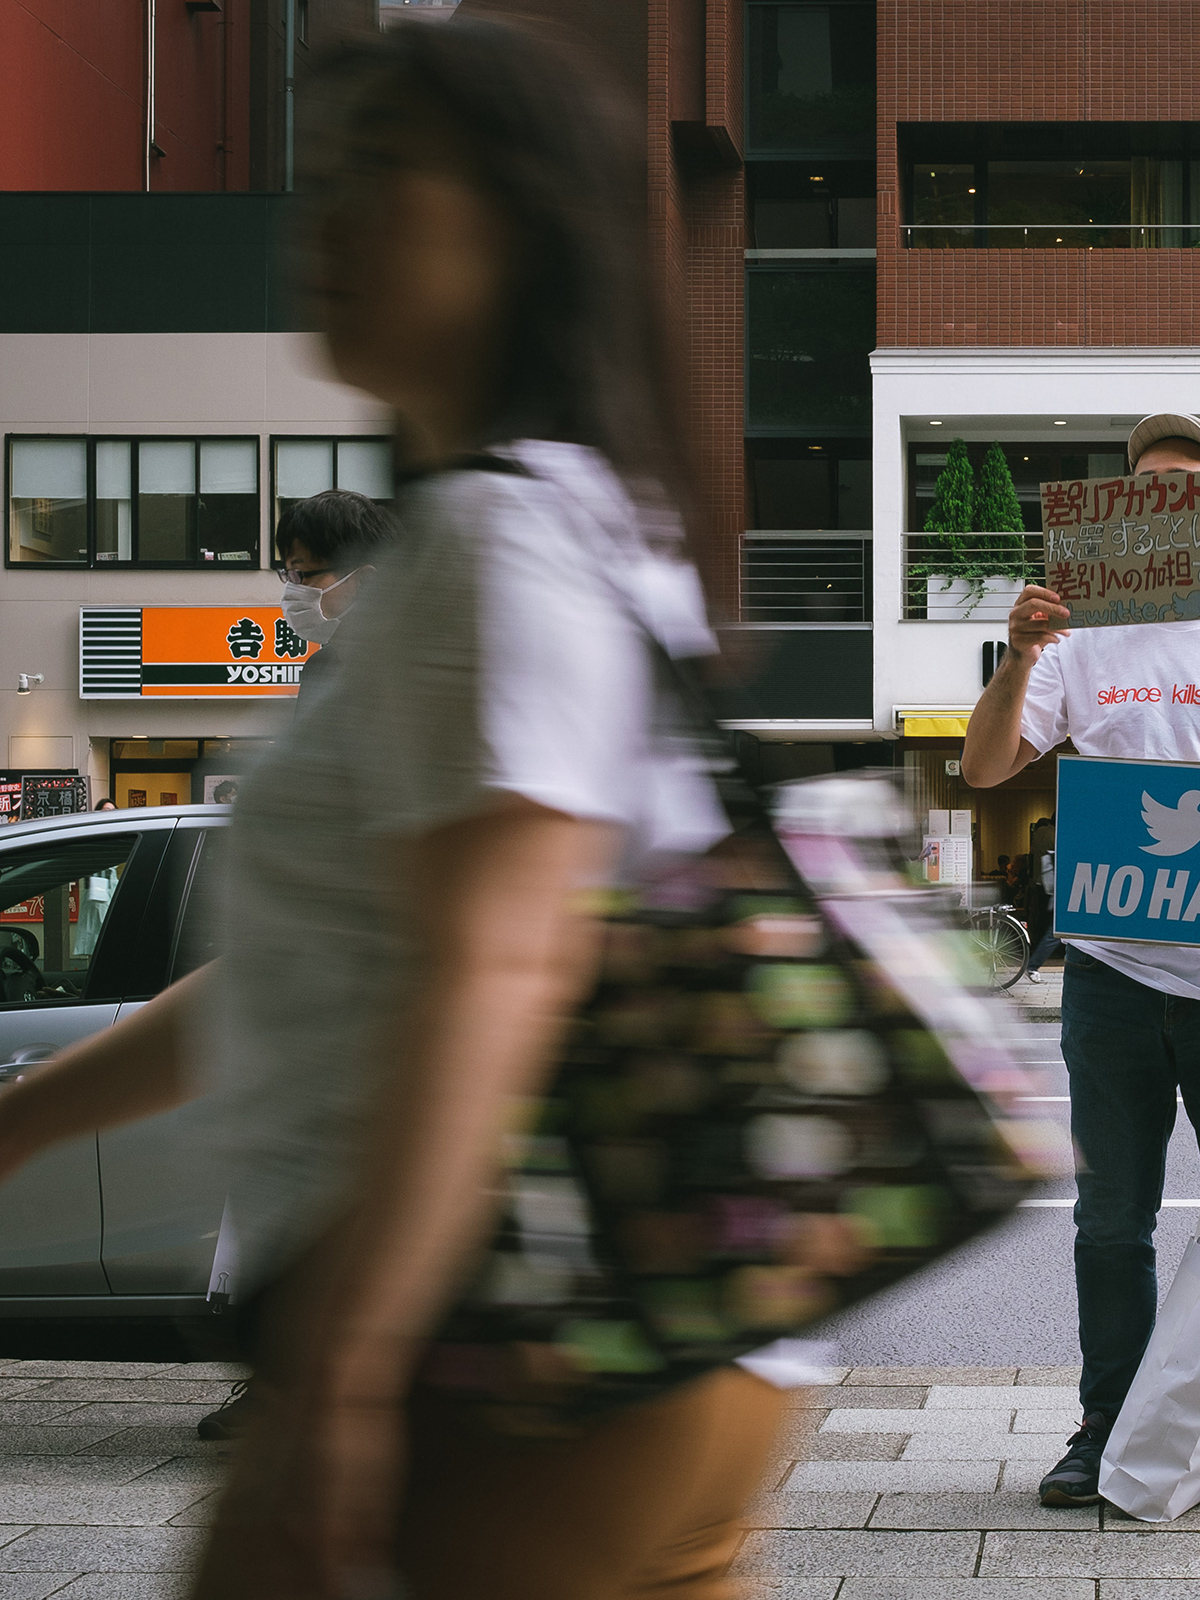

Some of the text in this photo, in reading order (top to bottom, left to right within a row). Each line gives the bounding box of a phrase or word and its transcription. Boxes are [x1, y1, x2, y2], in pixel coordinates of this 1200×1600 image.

[1066, 597, 1173, 628] twitter
[1097, 685, 1162, 706] silence
[36, 790, 73, 806] 京橋
[1067, 862, 1144, 917] NO
